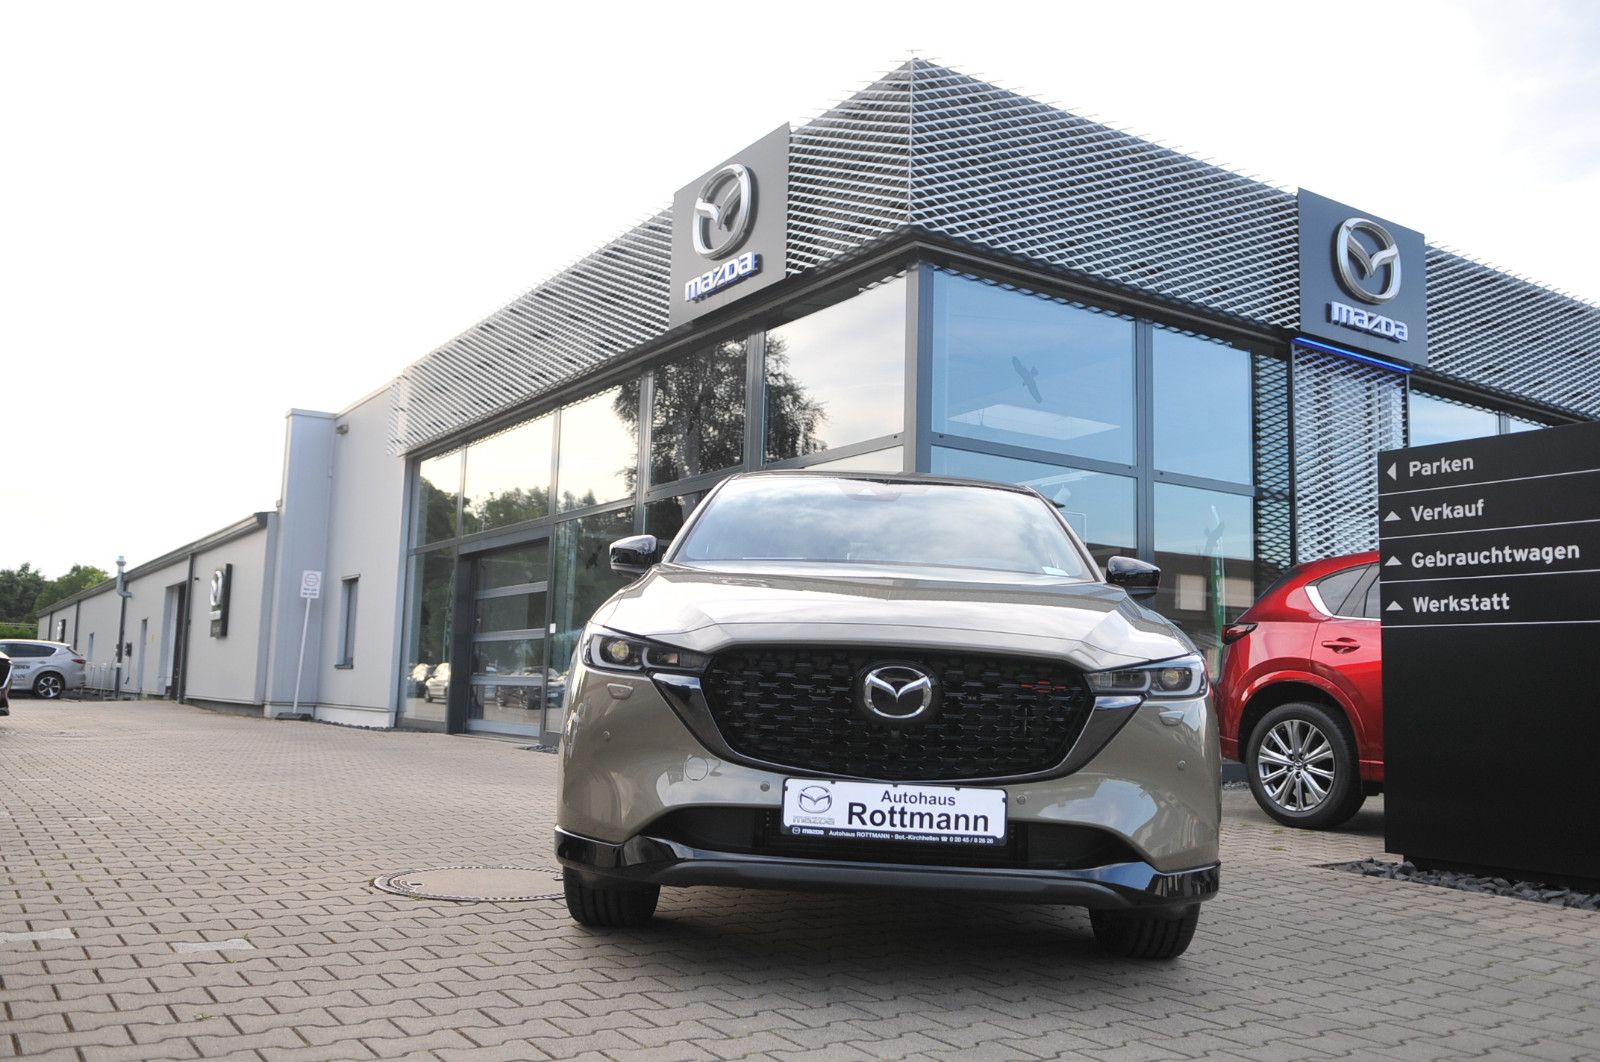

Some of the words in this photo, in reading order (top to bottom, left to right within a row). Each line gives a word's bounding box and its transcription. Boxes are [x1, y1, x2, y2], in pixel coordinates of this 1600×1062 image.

[684, 251, 756, 302] mazda
[1330, 301, 1409, 341] mazda
[1409, 457, 1475, 477] Parken
[1411, 499, 1485, 522] Verkauf
[1411, 544, 1581, 569] Gebrauchtwagen
[1412, 592, 1510, 613] Werkstatt
[881, 790, 956, 806] Autohaus
[793, 815, 835, 826] mazda
[848, 802, 989, 832] Rottmann
[829, 830, 855, 838] Autohaus
